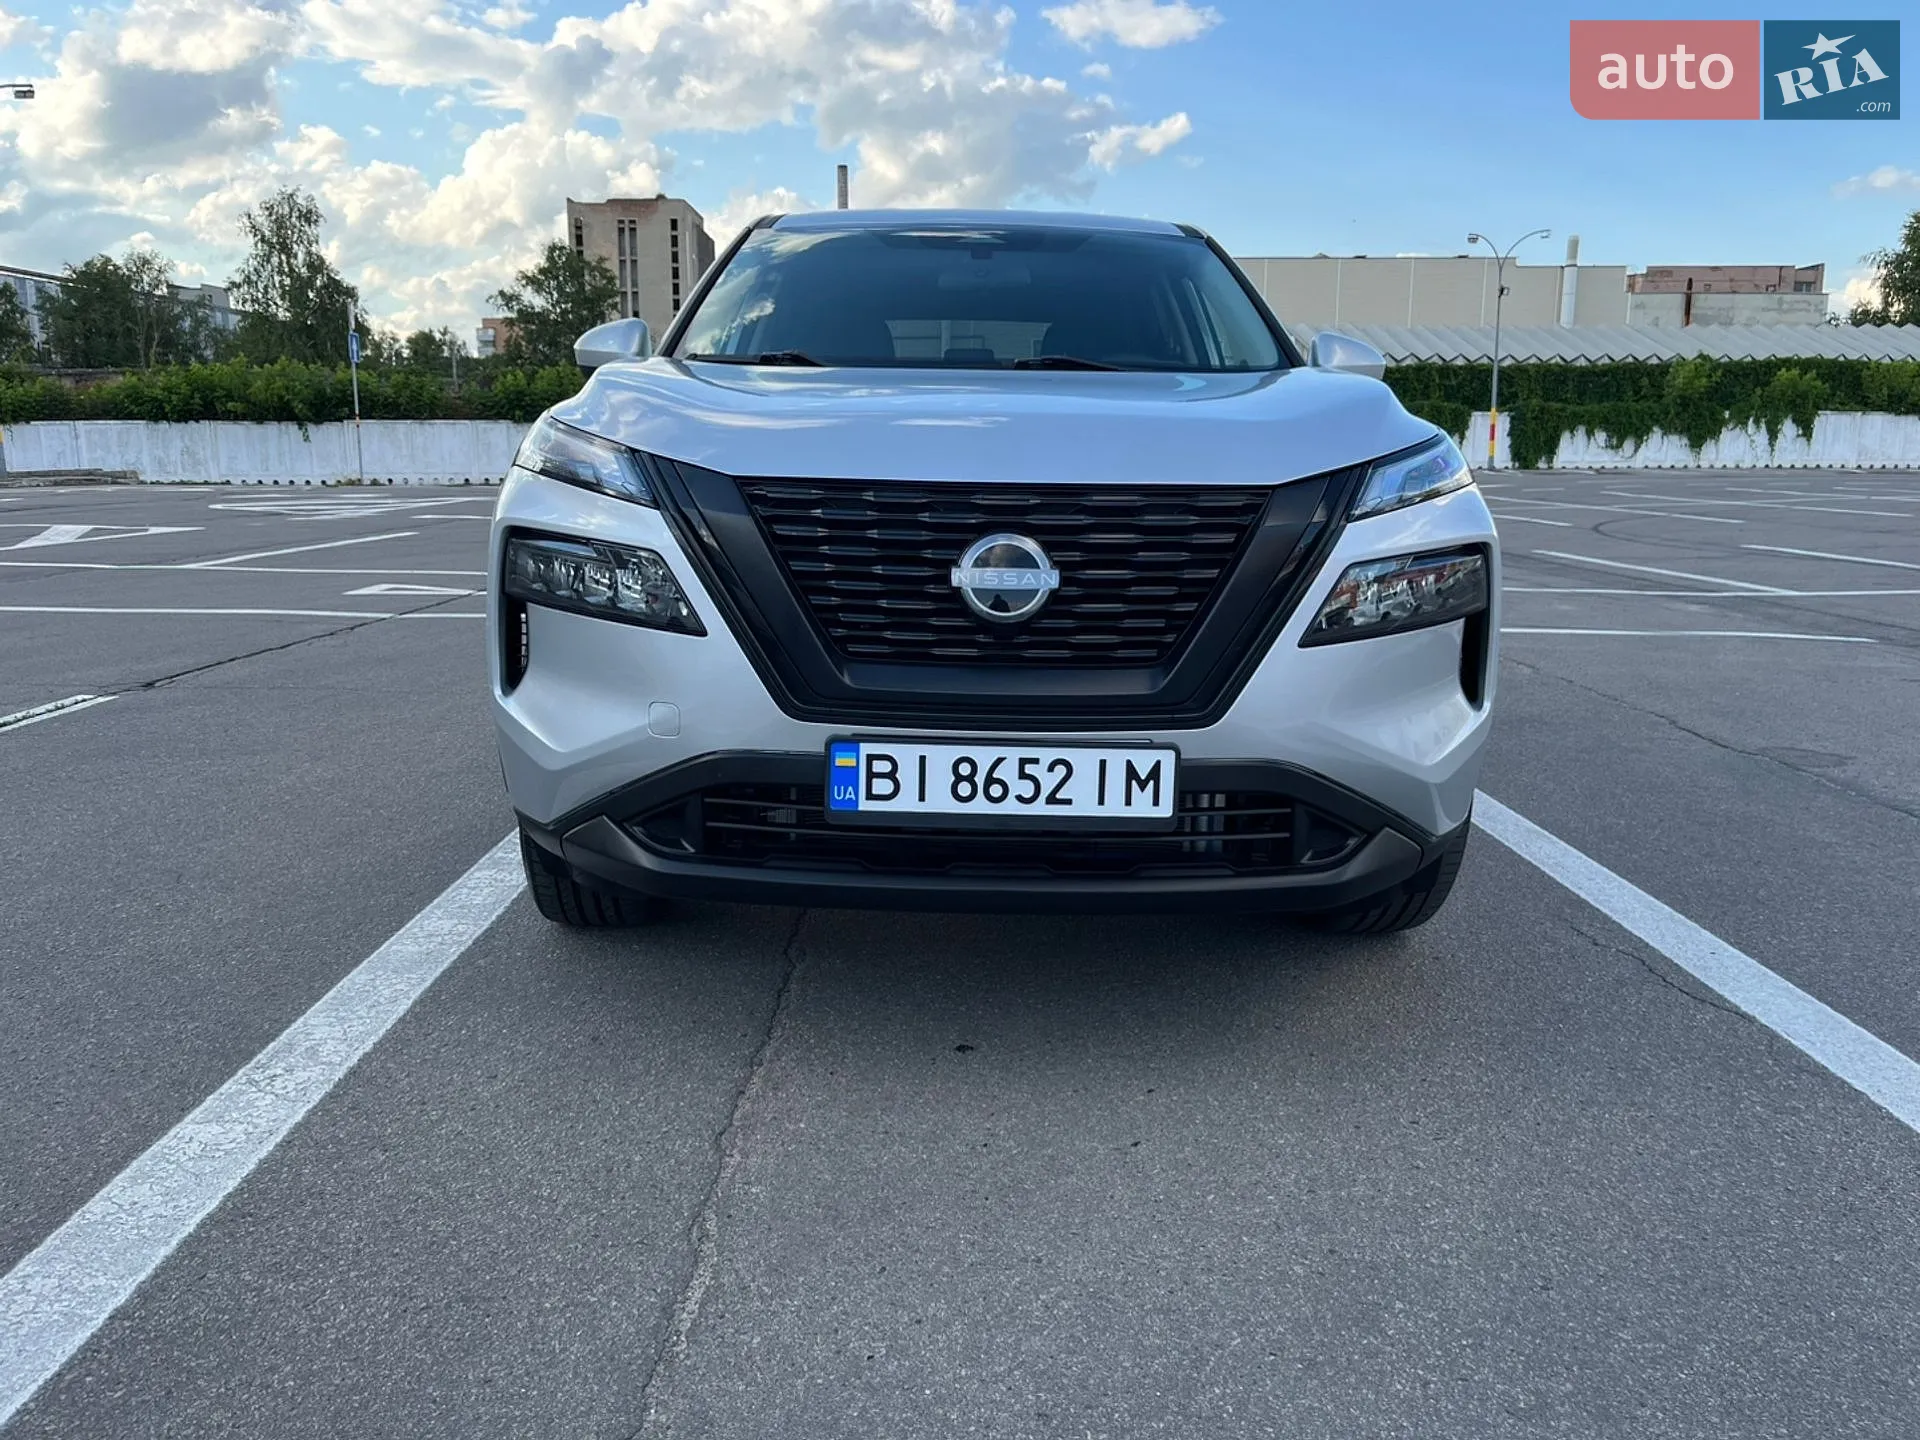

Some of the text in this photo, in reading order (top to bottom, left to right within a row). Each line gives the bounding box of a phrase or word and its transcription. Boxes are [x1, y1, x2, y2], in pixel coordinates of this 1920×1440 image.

[955, 572, 1055, 586] NISSAN
[865, 753, 1161, 807] BI 8652 IM
[834, 785, 856, 801] UA
